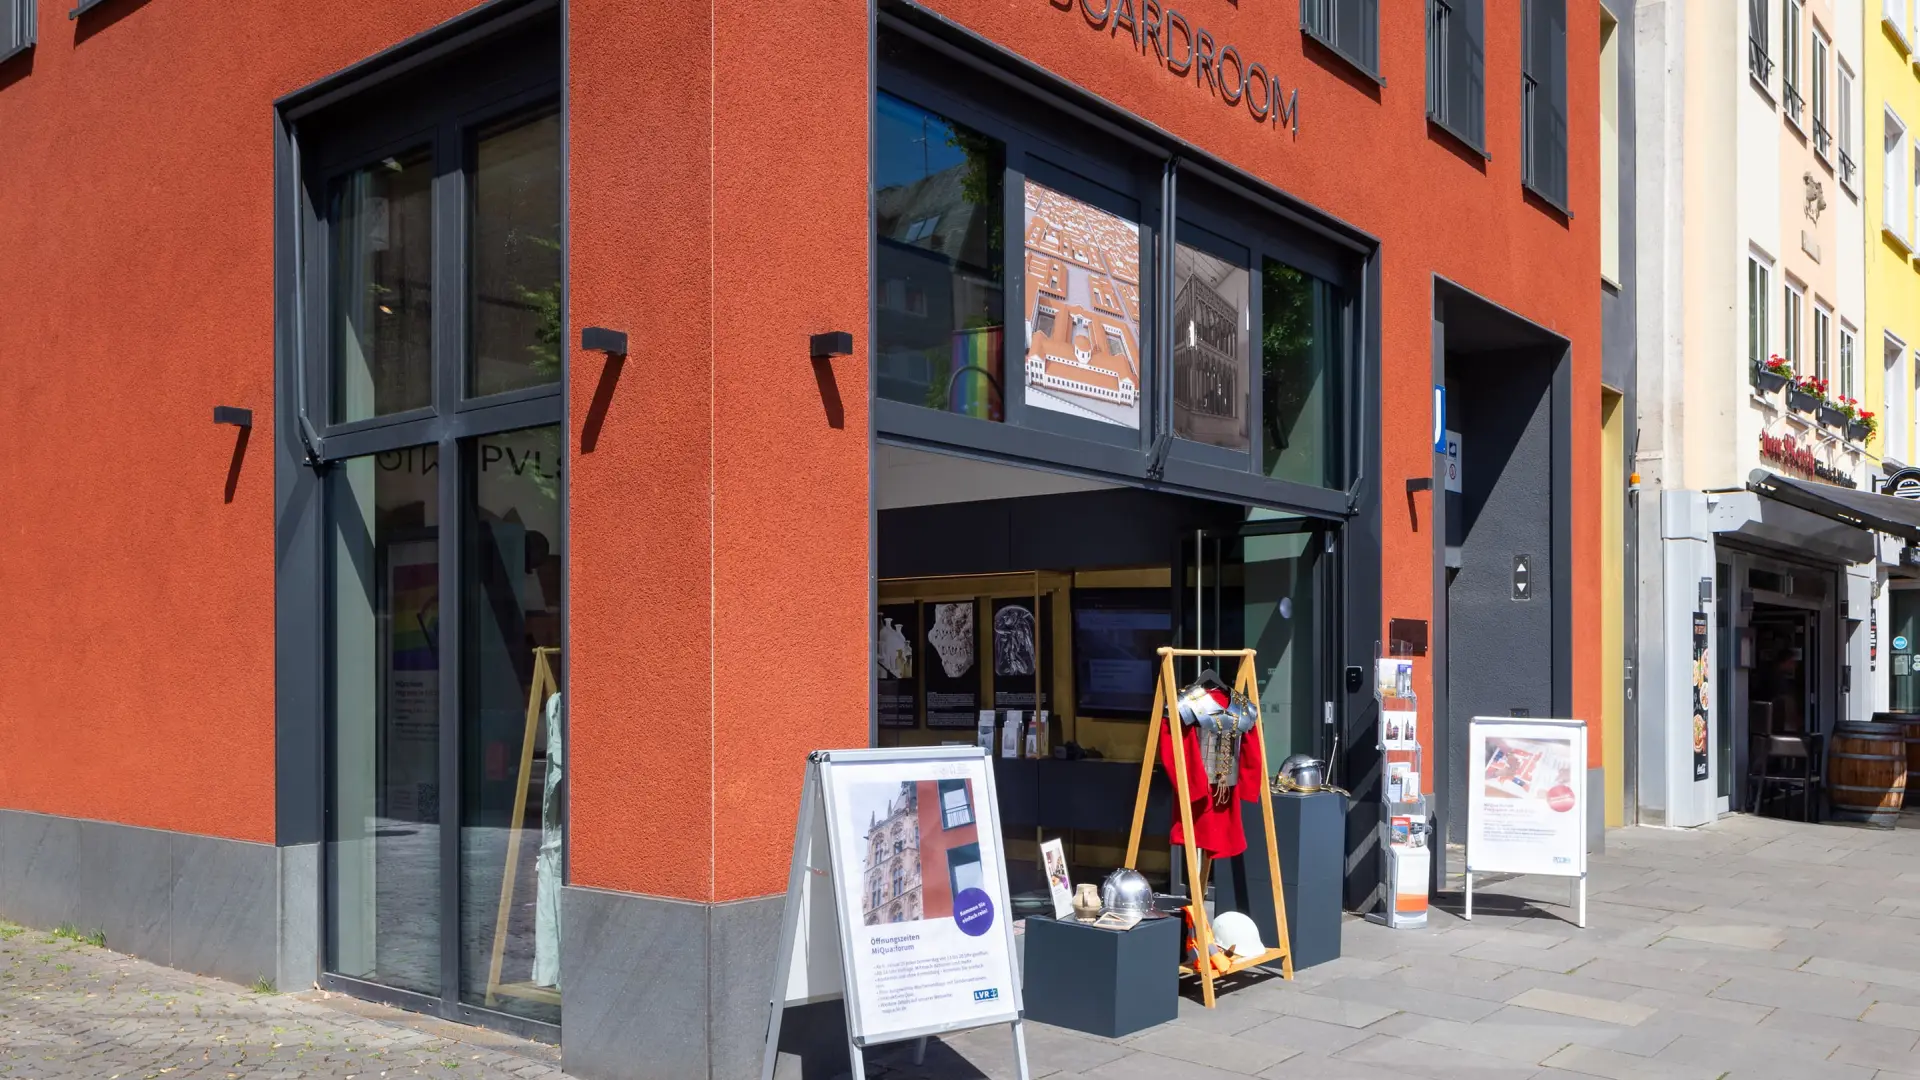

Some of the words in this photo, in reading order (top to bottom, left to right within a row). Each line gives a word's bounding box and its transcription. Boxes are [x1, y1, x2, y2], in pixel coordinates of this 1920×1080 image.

[1049, 0, 1298, 135] ARDROOM
[871, 934, 920, 946] Öffnungszeiten
[871, 944, 915, 955] MiQua:forum
[974, 989, 989, 1001] LVR
